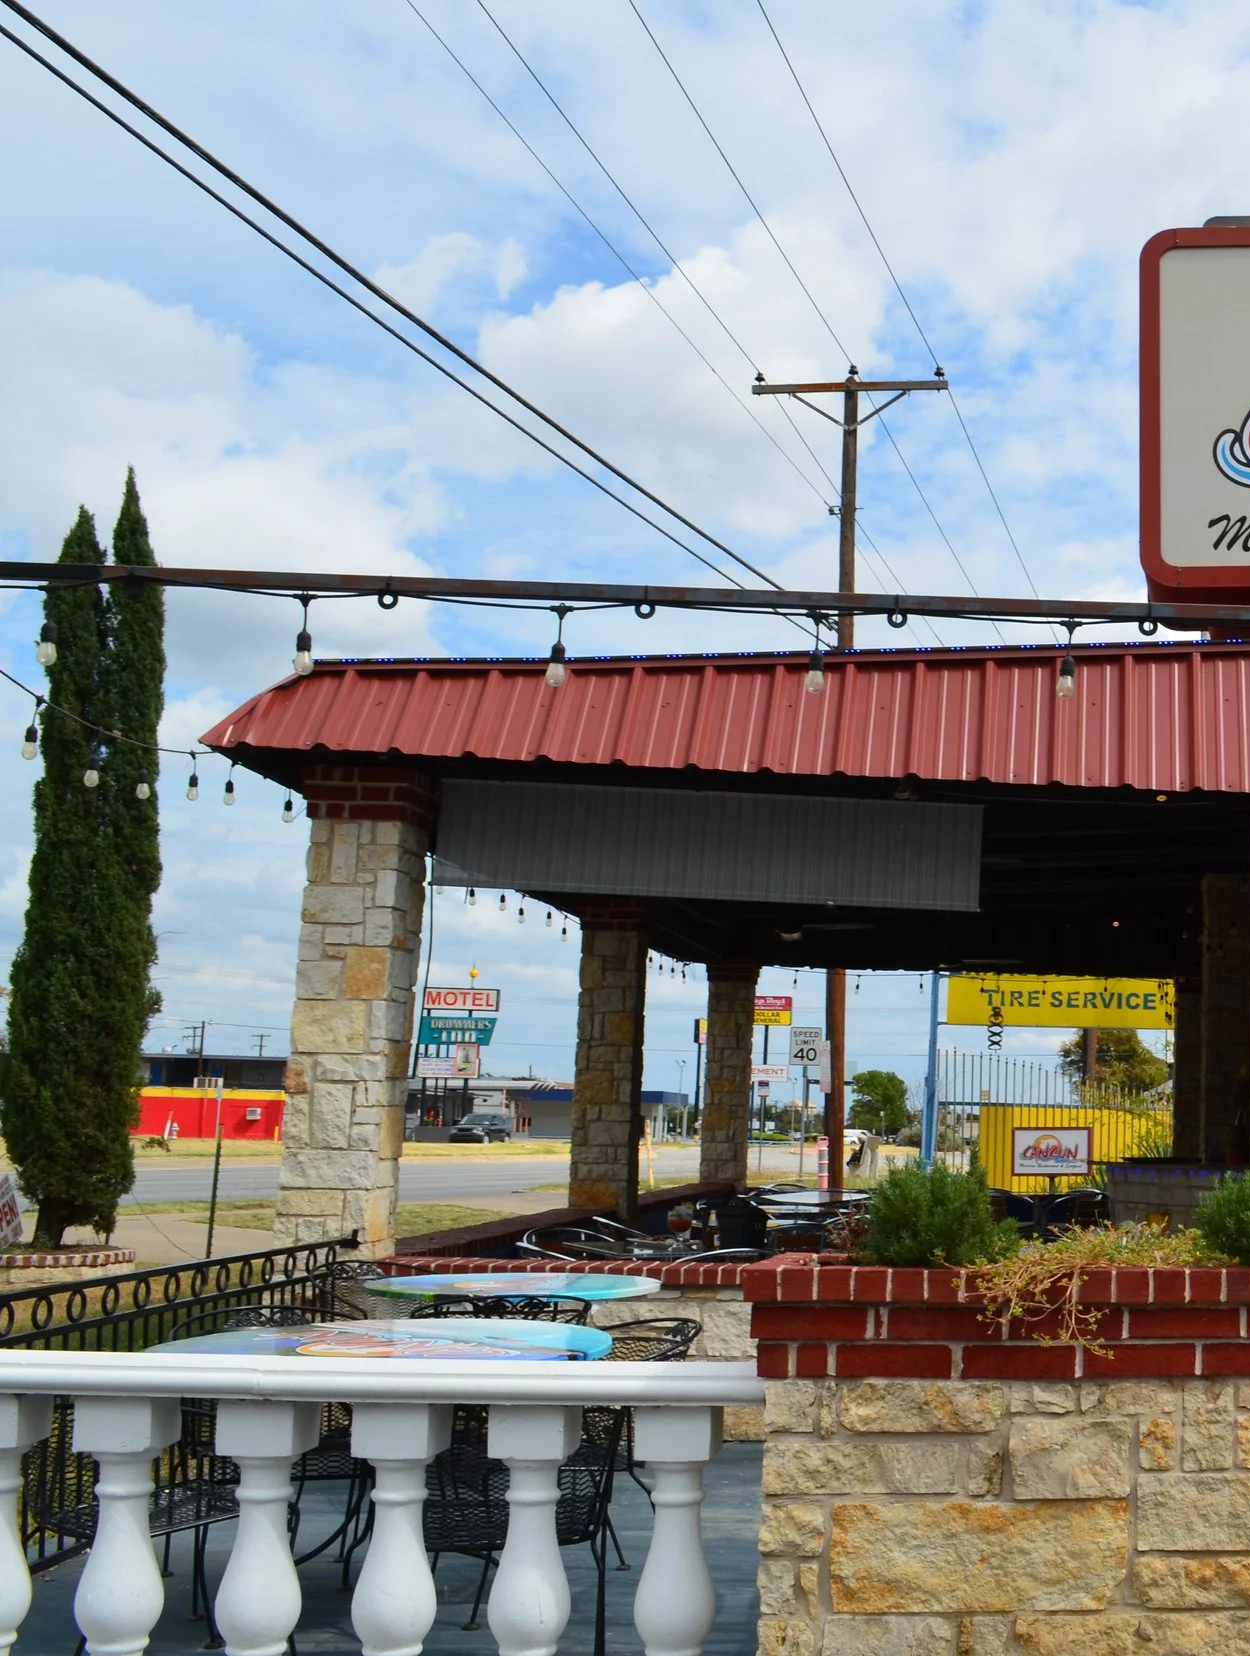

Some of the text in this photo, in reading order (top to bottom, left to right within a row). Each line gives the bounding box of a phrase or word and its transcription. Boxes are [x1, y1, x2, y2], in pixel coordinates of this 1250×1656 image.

[426, 991, 494, 1007] MOTEL
[984, 988, 1158, 1010] TIRE SERVICE
[431, 1018, 491, 1030] DRUMMERS
[793, 1047, 817, 1062] 40
